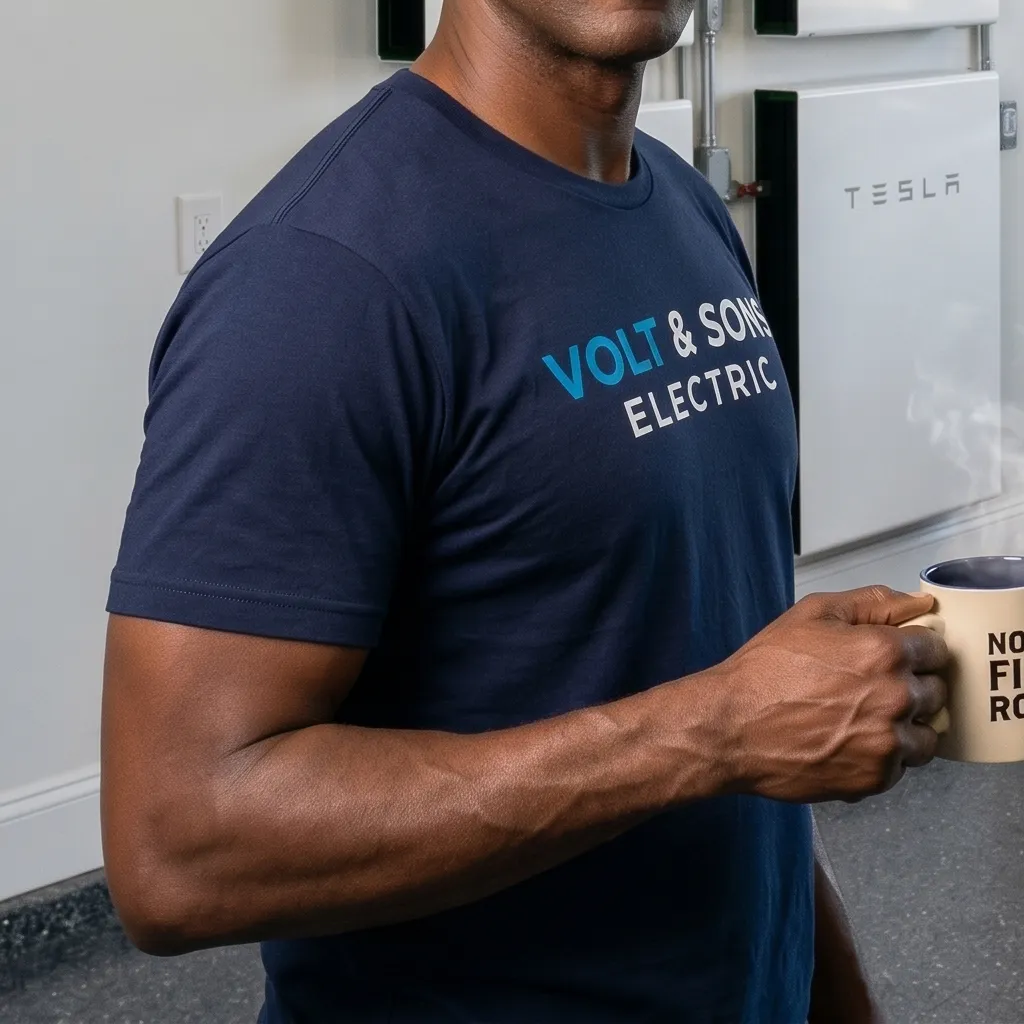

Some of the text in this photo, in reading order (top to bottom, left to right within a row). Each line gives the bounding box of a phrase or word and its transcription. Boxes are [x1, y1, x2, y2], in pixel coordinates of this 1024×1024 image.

[843, 173, 959, 209] TESLA
[541, 297, 773, 400] VOLT & SONS
[623, 356, 778, 439] ELECTRIC
